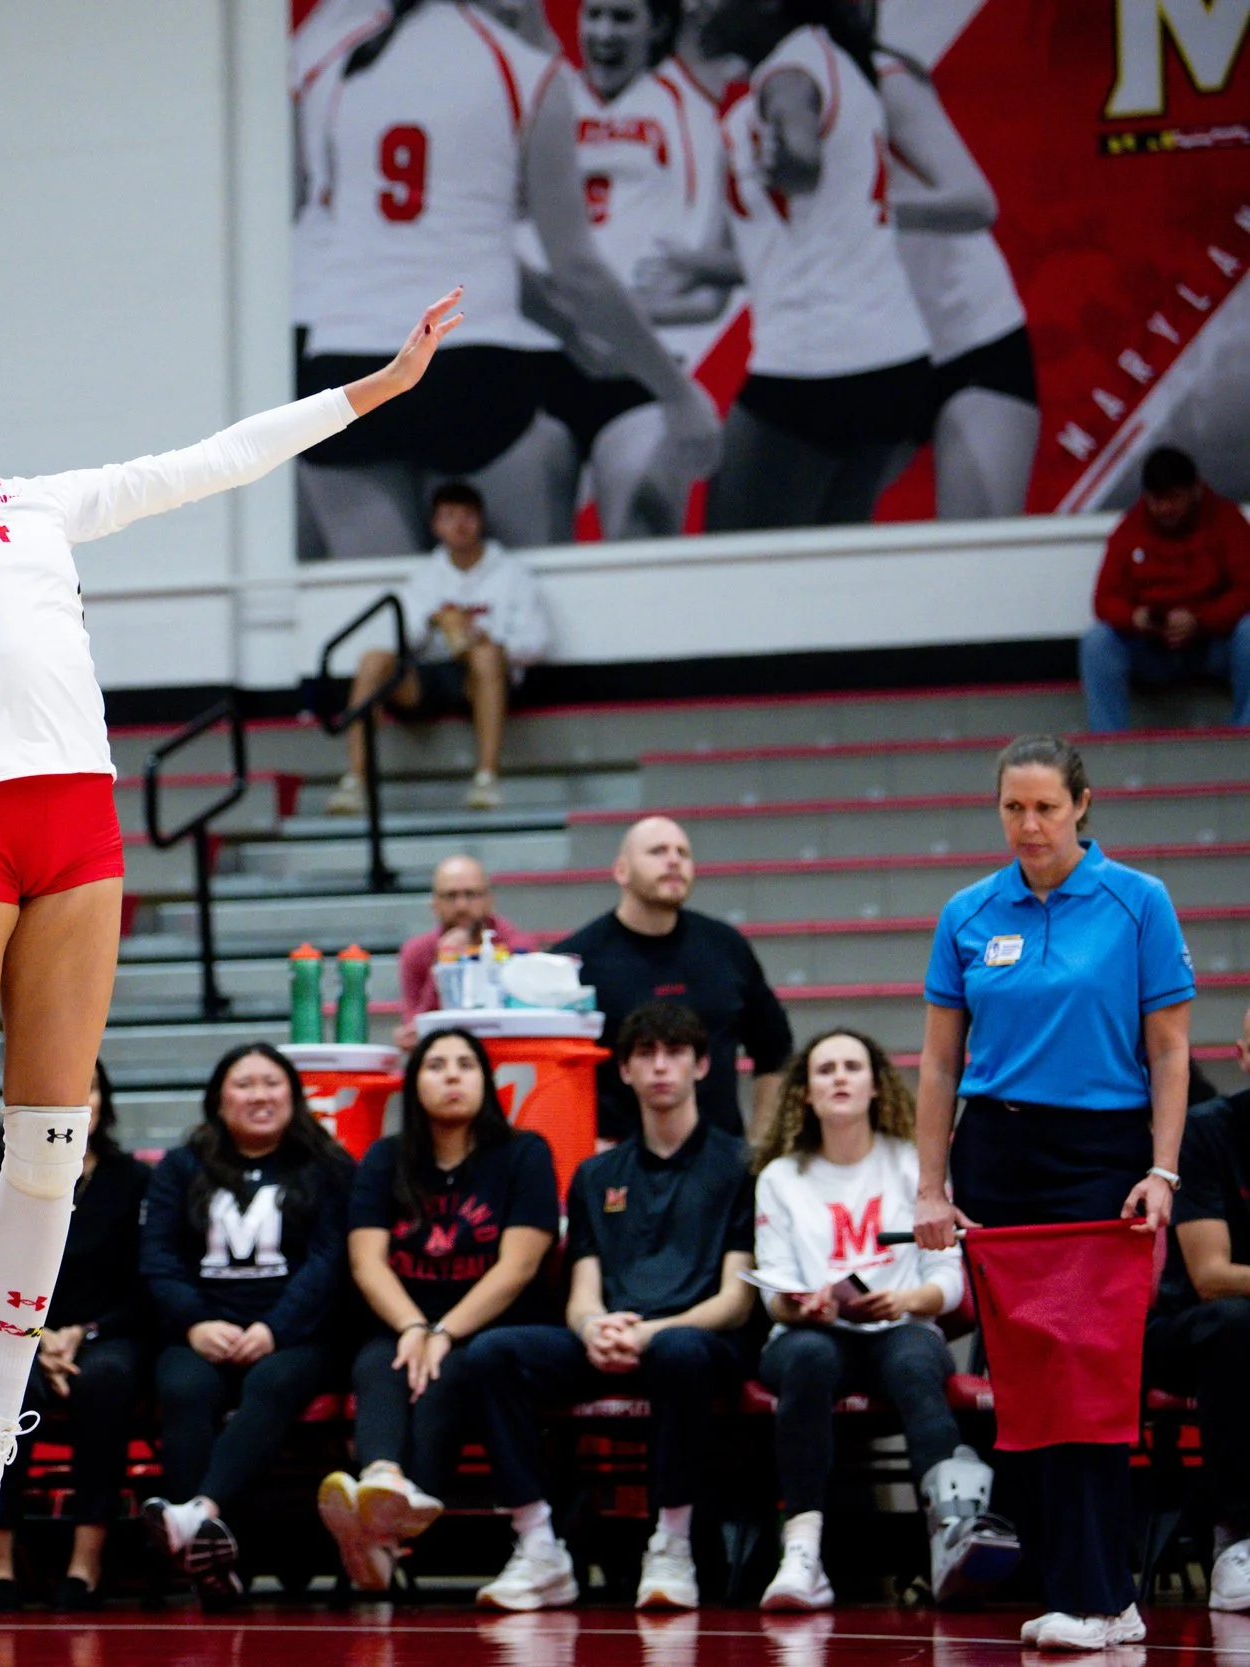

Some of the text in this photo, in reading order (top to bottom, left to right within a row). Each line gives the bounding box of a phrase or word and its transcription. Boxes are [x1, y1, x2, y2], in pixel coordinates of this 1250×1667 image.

[379, 122, 428, 223] 9
[200, 1184, 288, 1267] M
[827, 1194, 893, 1261] M
